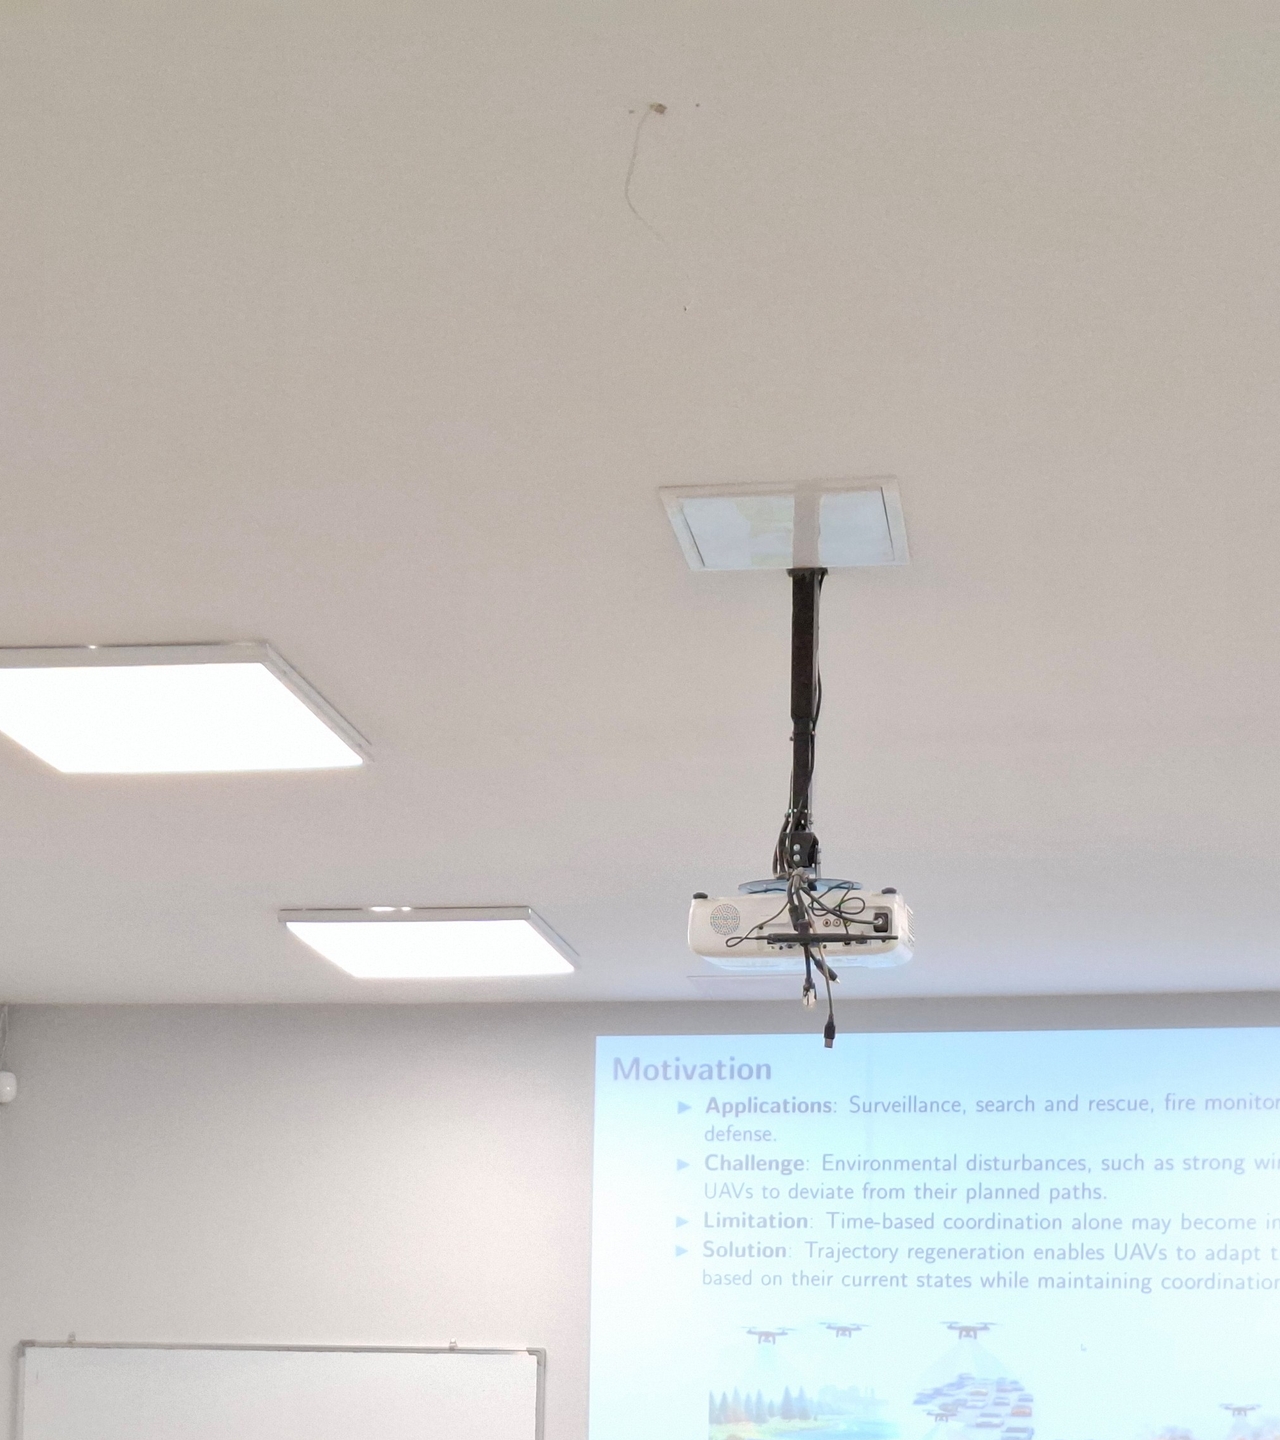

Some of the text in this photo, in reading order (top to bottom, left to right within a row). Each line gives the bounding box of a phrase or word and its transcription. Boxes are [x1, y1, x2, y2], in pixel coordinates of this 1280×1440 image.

[612, 1056, 772, 1082] Motivation
[704, 1096, 837, 1120] Applications:
[848, 1094, 967, 1118] Surveillance,
[975, 1095, 1036, 1115] search
[1043, 1094, 1080, 1114] and
[1088, 1099, 1155, 1116] rescue,
[1163, 1092, 1197, 1114] fire
[703, 1124, 778, 1144] defense.
[704, 1154, 810, 1177] Challenge:
[821, 1153, 958, 1174] Environmental
[965, 1153, 1092, 1176] disturbances,
[1100, 1152, 1145, 1173] such
[1153, 1158, 1175, 1173] as
[1182, 1156, 1246, 1176] strong
[703, 1181, 1108, 1207] UAVs to deviate from their planned paths.
[703, 1211, 814, 1231] Limitation:
[825, 1212, 935, 1232] Time-based
[942, 1212, 1063, 1233] coordination
[1071, 1213, 1124, 1233] alone
[1131, 1218, 1172, 1236] may
[1180, 1212, 1258, 1232] become
[702, 1240, 792, 1261] Solution:
[804, 1241, 900, 1265] Trajectory
[907, 1242, 1025, 1266] regeneration
[1032, 1242, 1106, 1262] enables
[1113, 1242, 1168, 1263] UAVs
[1175, 1246, 1197, 1263] to
[1204, 1243, 1261, 1267] adapt
[701, 1269, 753, 1289] based
[760, 1274, 783, 1288] on
[791, 1269, 834, 1289] their
[840, 1272, 909, 1290] current
[916, 1273, 973, 1291] states
[979, 1271, 1030, 1290] while
[1037, 1271, 1153, 1297] maintaining
